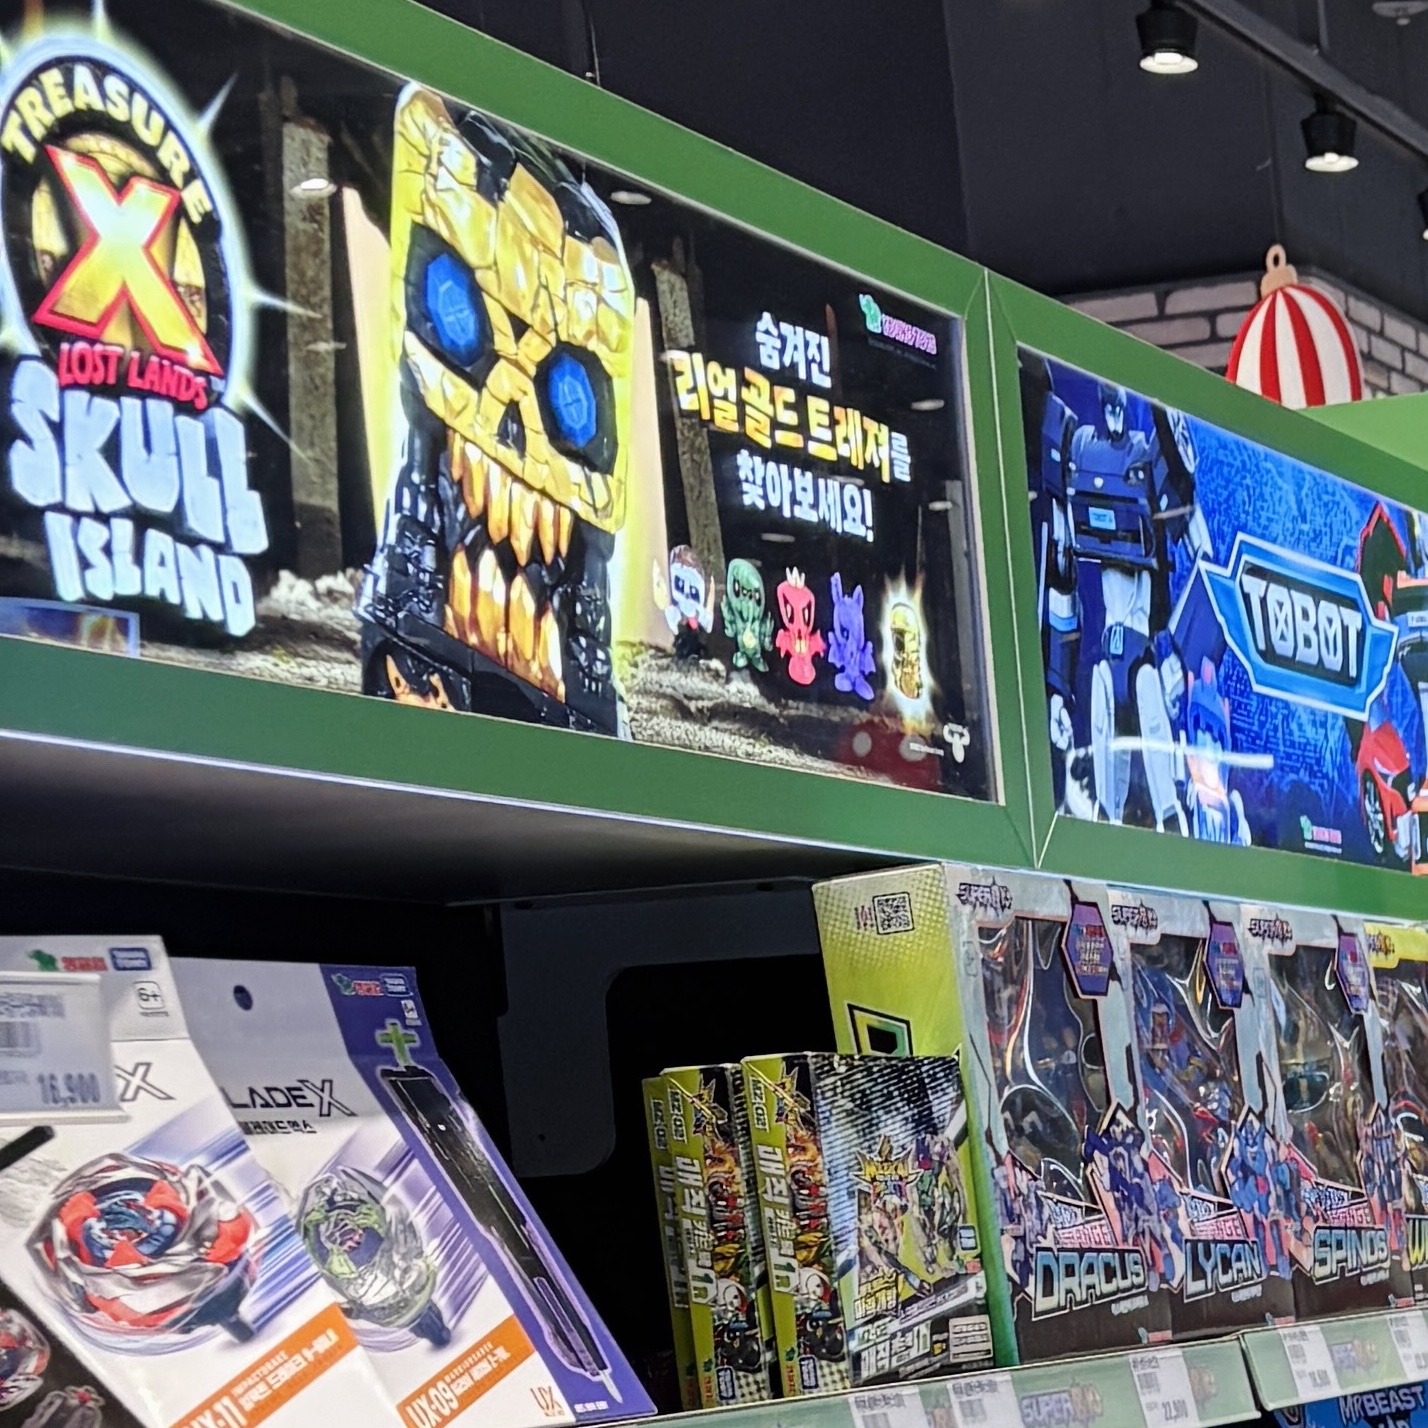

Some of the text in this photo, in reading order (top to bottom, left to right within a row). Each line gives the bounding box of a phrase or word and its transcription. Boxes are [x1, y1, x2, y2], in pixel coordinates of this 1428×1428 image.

[0, 66, 213, 224] TREASURE
[33, 144, 224, 376] X
[59, 342, 209, 411] LOST LANDS
[756, 311, 832, 389] 숨겨진
[10, 359, 269, 556] SKULL
[736, 449, 875, 543] 찾아보세요!
[44, 512, 256, 638] ISLAND
[1240, 572, 1363, 679] TOBOT
[1034, 1249, 1147, 1313] DRACUS
[1185, 1239, 1265, 1300] LYCAN
